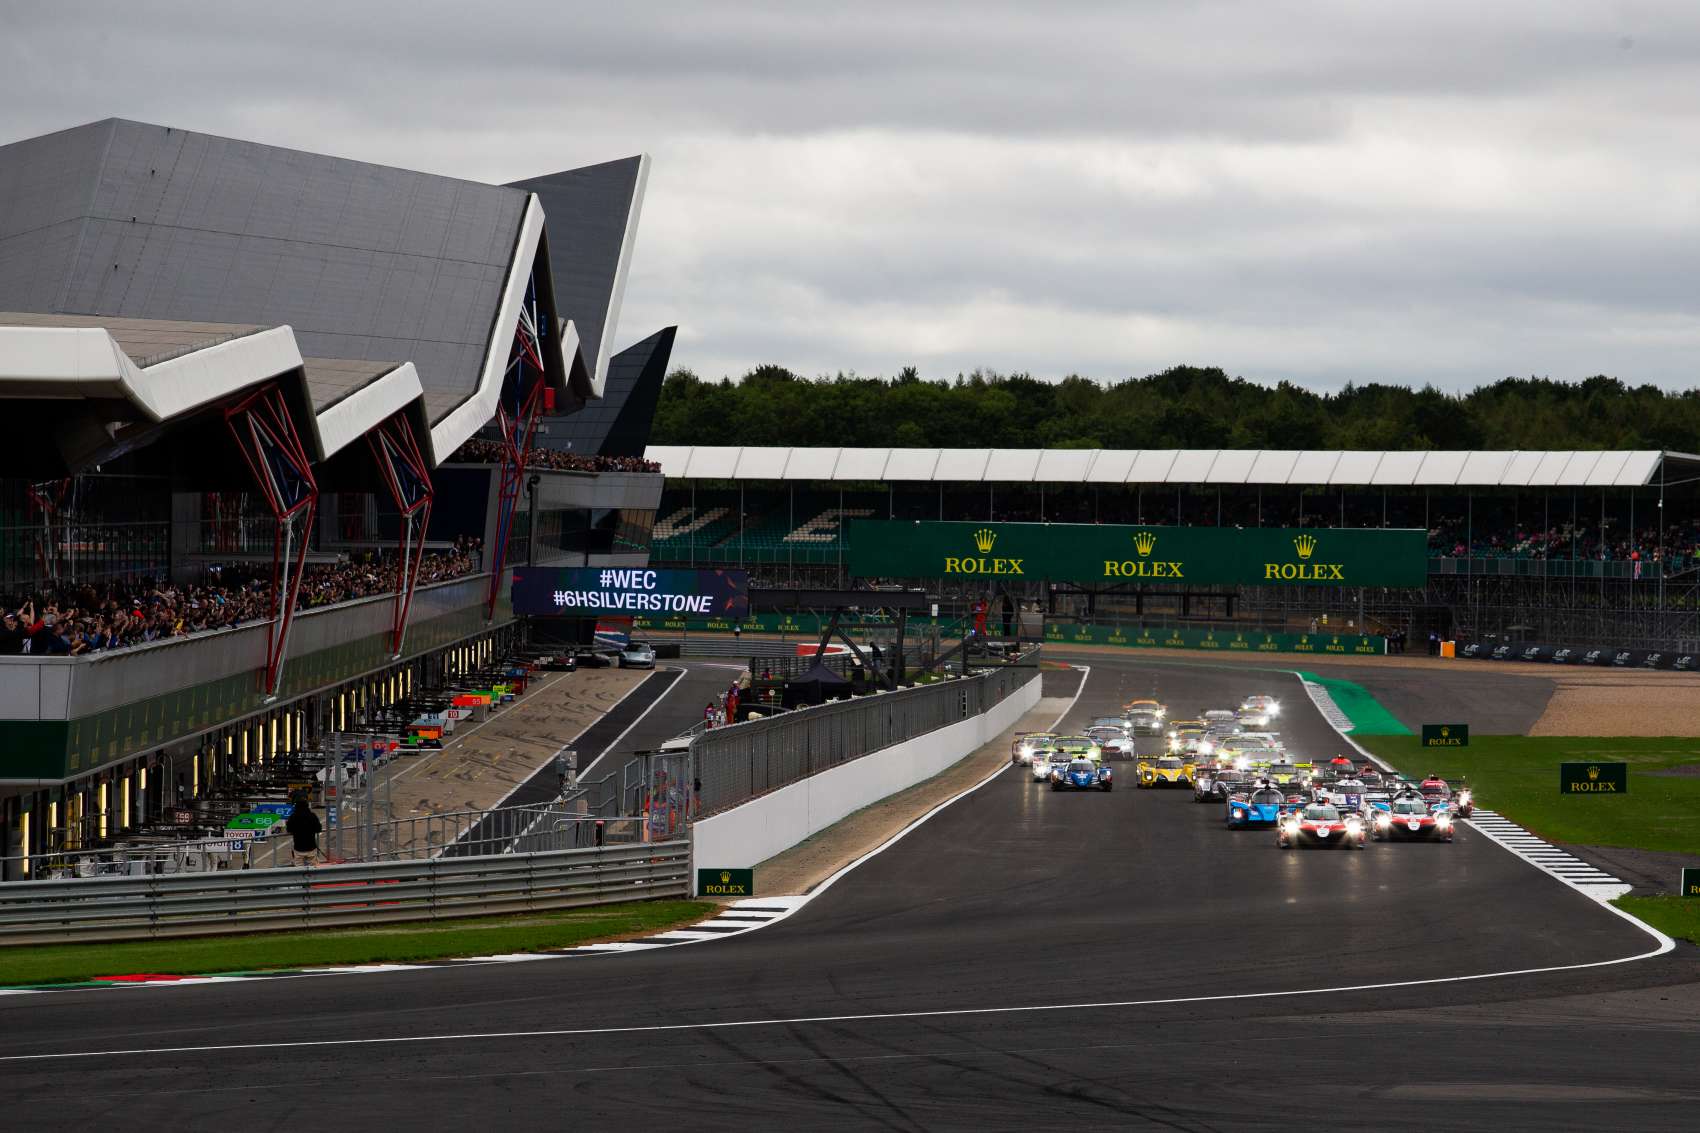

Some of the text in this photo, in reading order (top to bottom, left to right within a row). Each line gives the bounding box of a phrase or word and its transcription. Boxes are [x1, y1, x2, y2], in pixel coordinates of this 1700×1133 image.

[944, 557, 1024, 575] ROLEX
[1103, 560, 1184, 577] ROLEX
[1263, 563, 1344, 580] ROLEX
[600, 569, 656, 589] #WEC
[553, 590, 714, 613] #6HSILVERSTONE
[1429, 737, 1461, 745] ROLEX
[1570, 782, 1616, 792] ROLEX
[234, 839, 242, 850] 8
[706, 885, 744, 893] ROLEX
